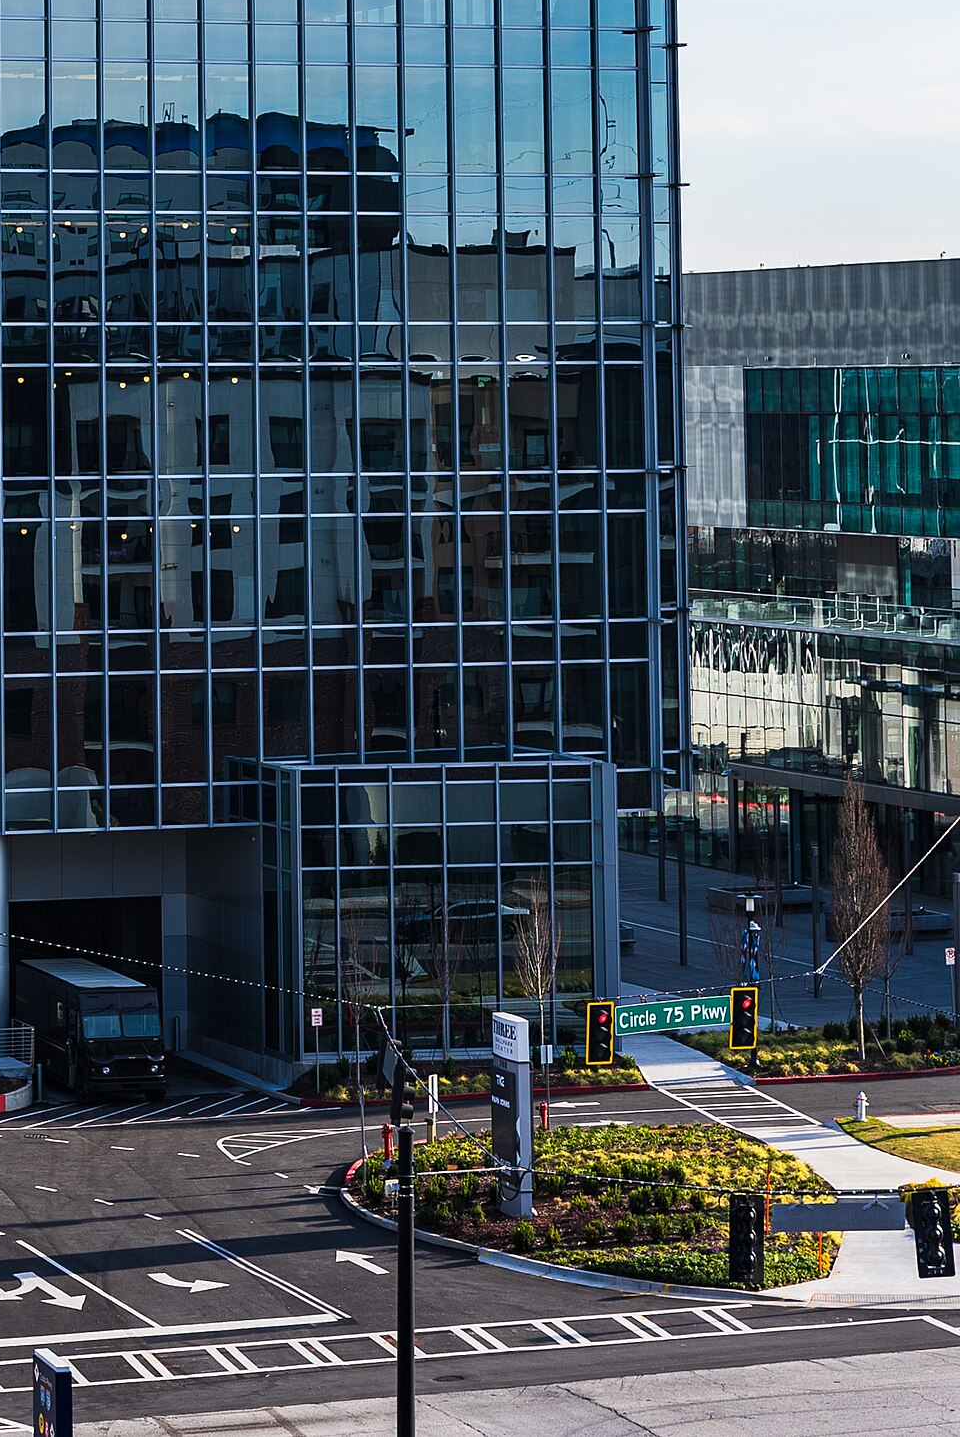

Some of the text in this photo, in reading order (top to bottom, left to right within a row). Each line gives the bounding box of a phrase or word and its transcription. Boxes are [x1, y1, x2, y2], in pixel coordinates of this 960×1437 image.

[619, 1004, 728, 1029] Circle 75 Pkwy
[493, 1019, 516, 1040] THREE
